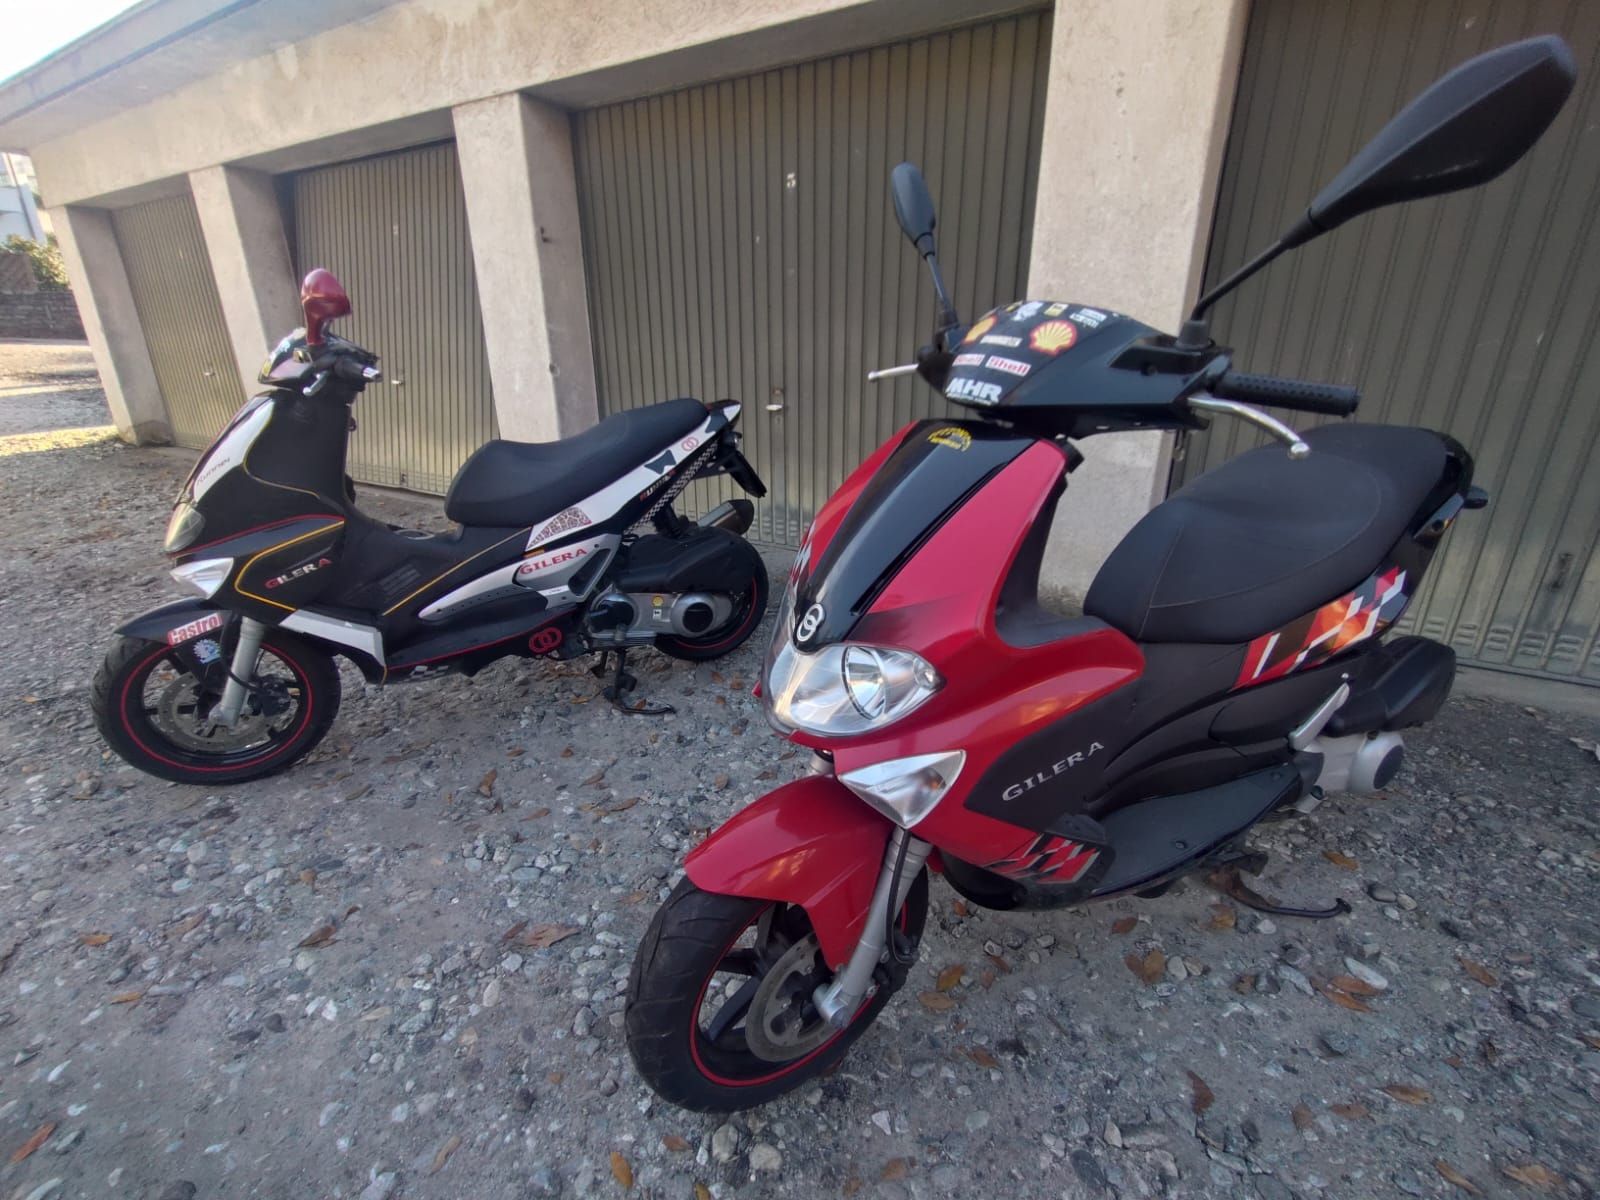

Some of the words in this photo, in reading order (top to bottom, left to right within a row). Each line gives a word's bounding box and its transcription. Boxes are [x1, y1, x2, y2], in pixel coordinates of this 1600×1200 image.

[945, 377, 1002, 403] MHR
[264, 558, 332, 589] GILERA
[519, 548, 588, 575] GILERA
[168, 614, 224, 647] Castrol
[1002, 741, 1105, 801] GILERA
